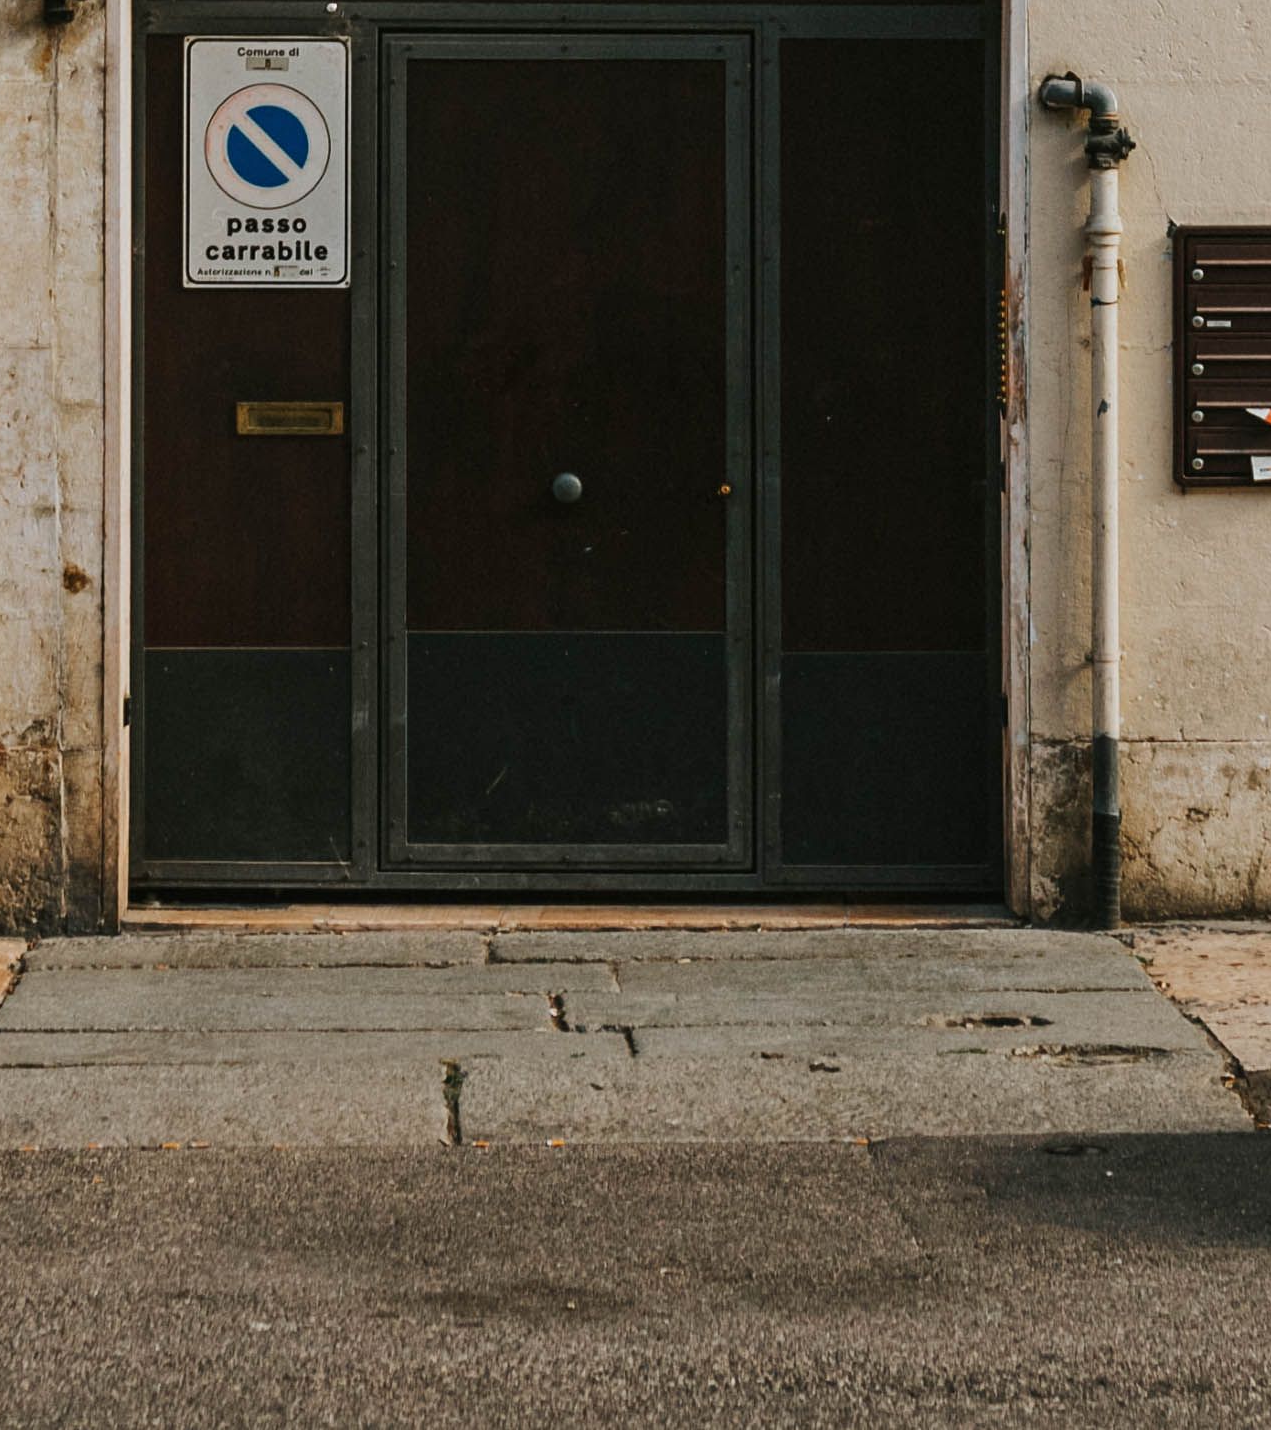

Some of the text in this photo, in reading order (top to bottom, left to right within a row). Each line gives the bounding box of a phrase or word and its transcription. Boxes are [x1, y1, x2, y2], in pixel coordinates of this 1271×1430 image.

[237, 46, 300, 58] Comune di
[227, 217, 307, 237] passo
[205, 240, 329, 261] carrabile
[197, 268, 262, 277] Autorizzazione
